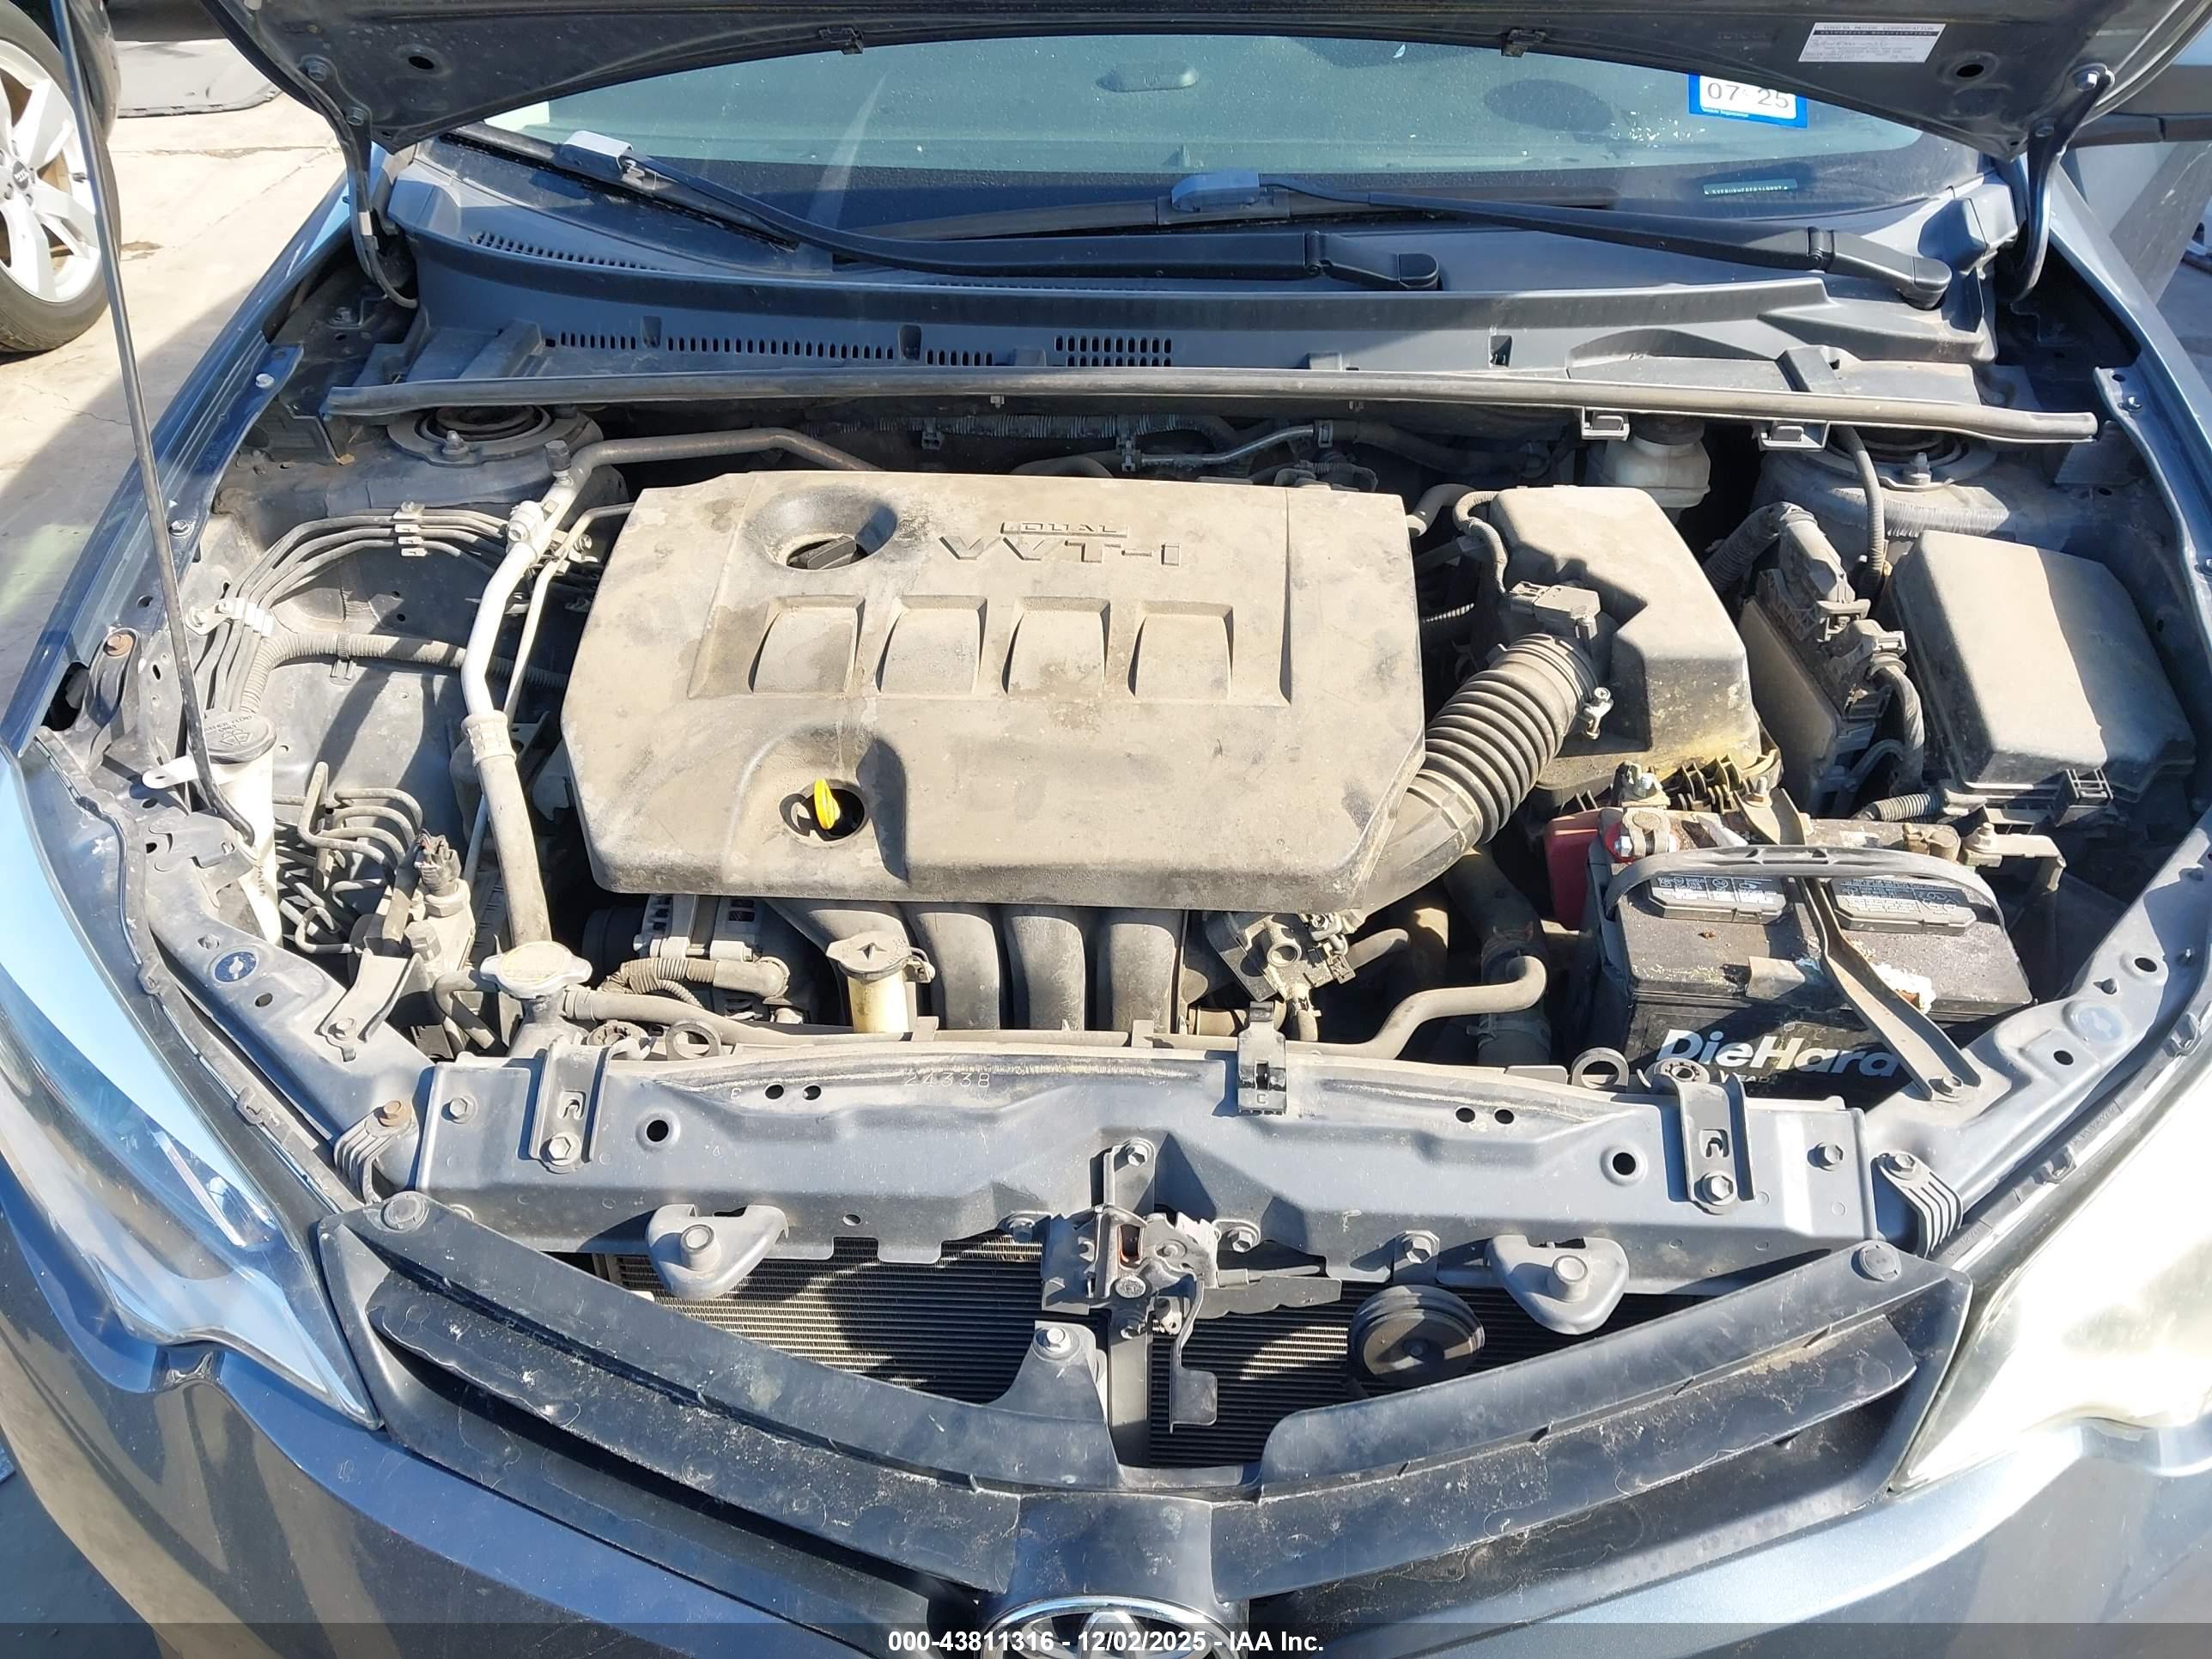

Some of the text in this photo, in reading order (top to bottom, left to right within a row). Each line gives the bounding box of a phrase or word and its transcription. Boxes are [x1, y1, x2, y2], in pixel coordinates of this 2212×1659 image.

[1707, 82, 1790, 108] 07 25
[903, 1072, 990, 1088] 24338
